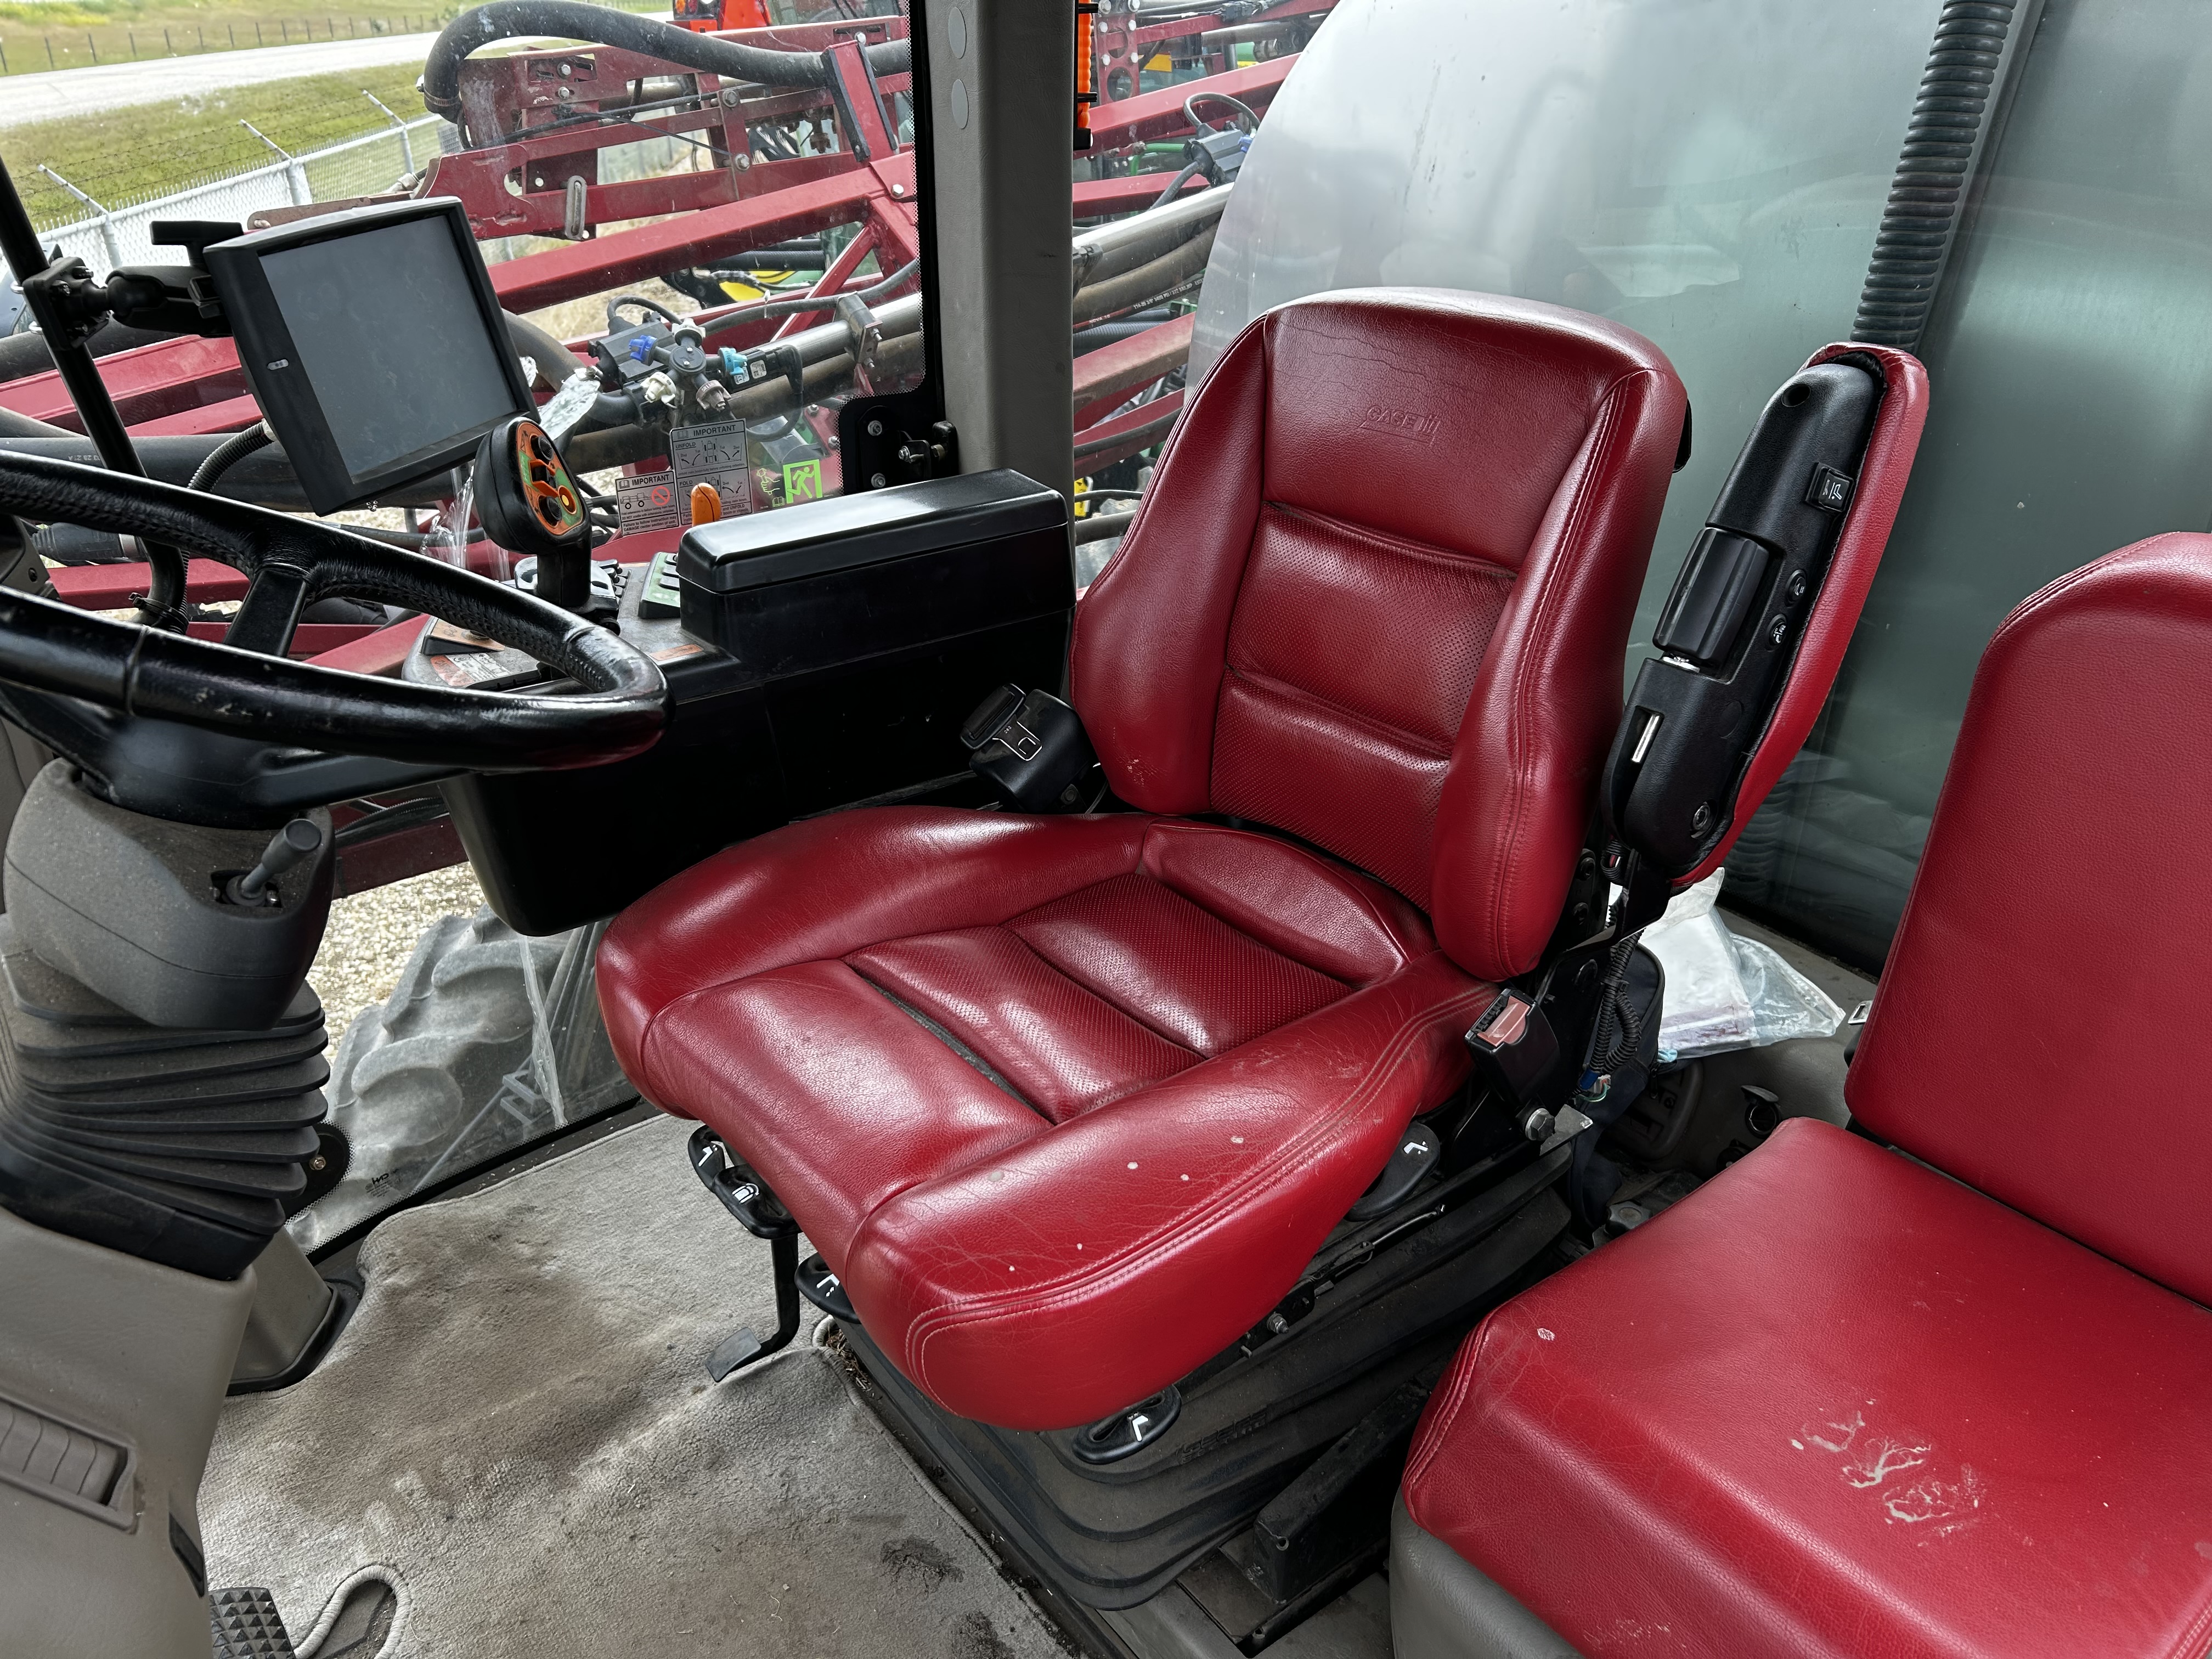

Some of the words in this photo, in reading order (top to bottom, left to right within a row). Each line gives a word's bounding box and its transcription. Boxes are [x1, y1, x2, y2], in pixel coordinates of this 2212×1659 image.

[1365, 405, 1419, 430] CASE
[693, 425, 736, 437] IMPORTANT
[631, 474, 669, 486] IMPORTANT
